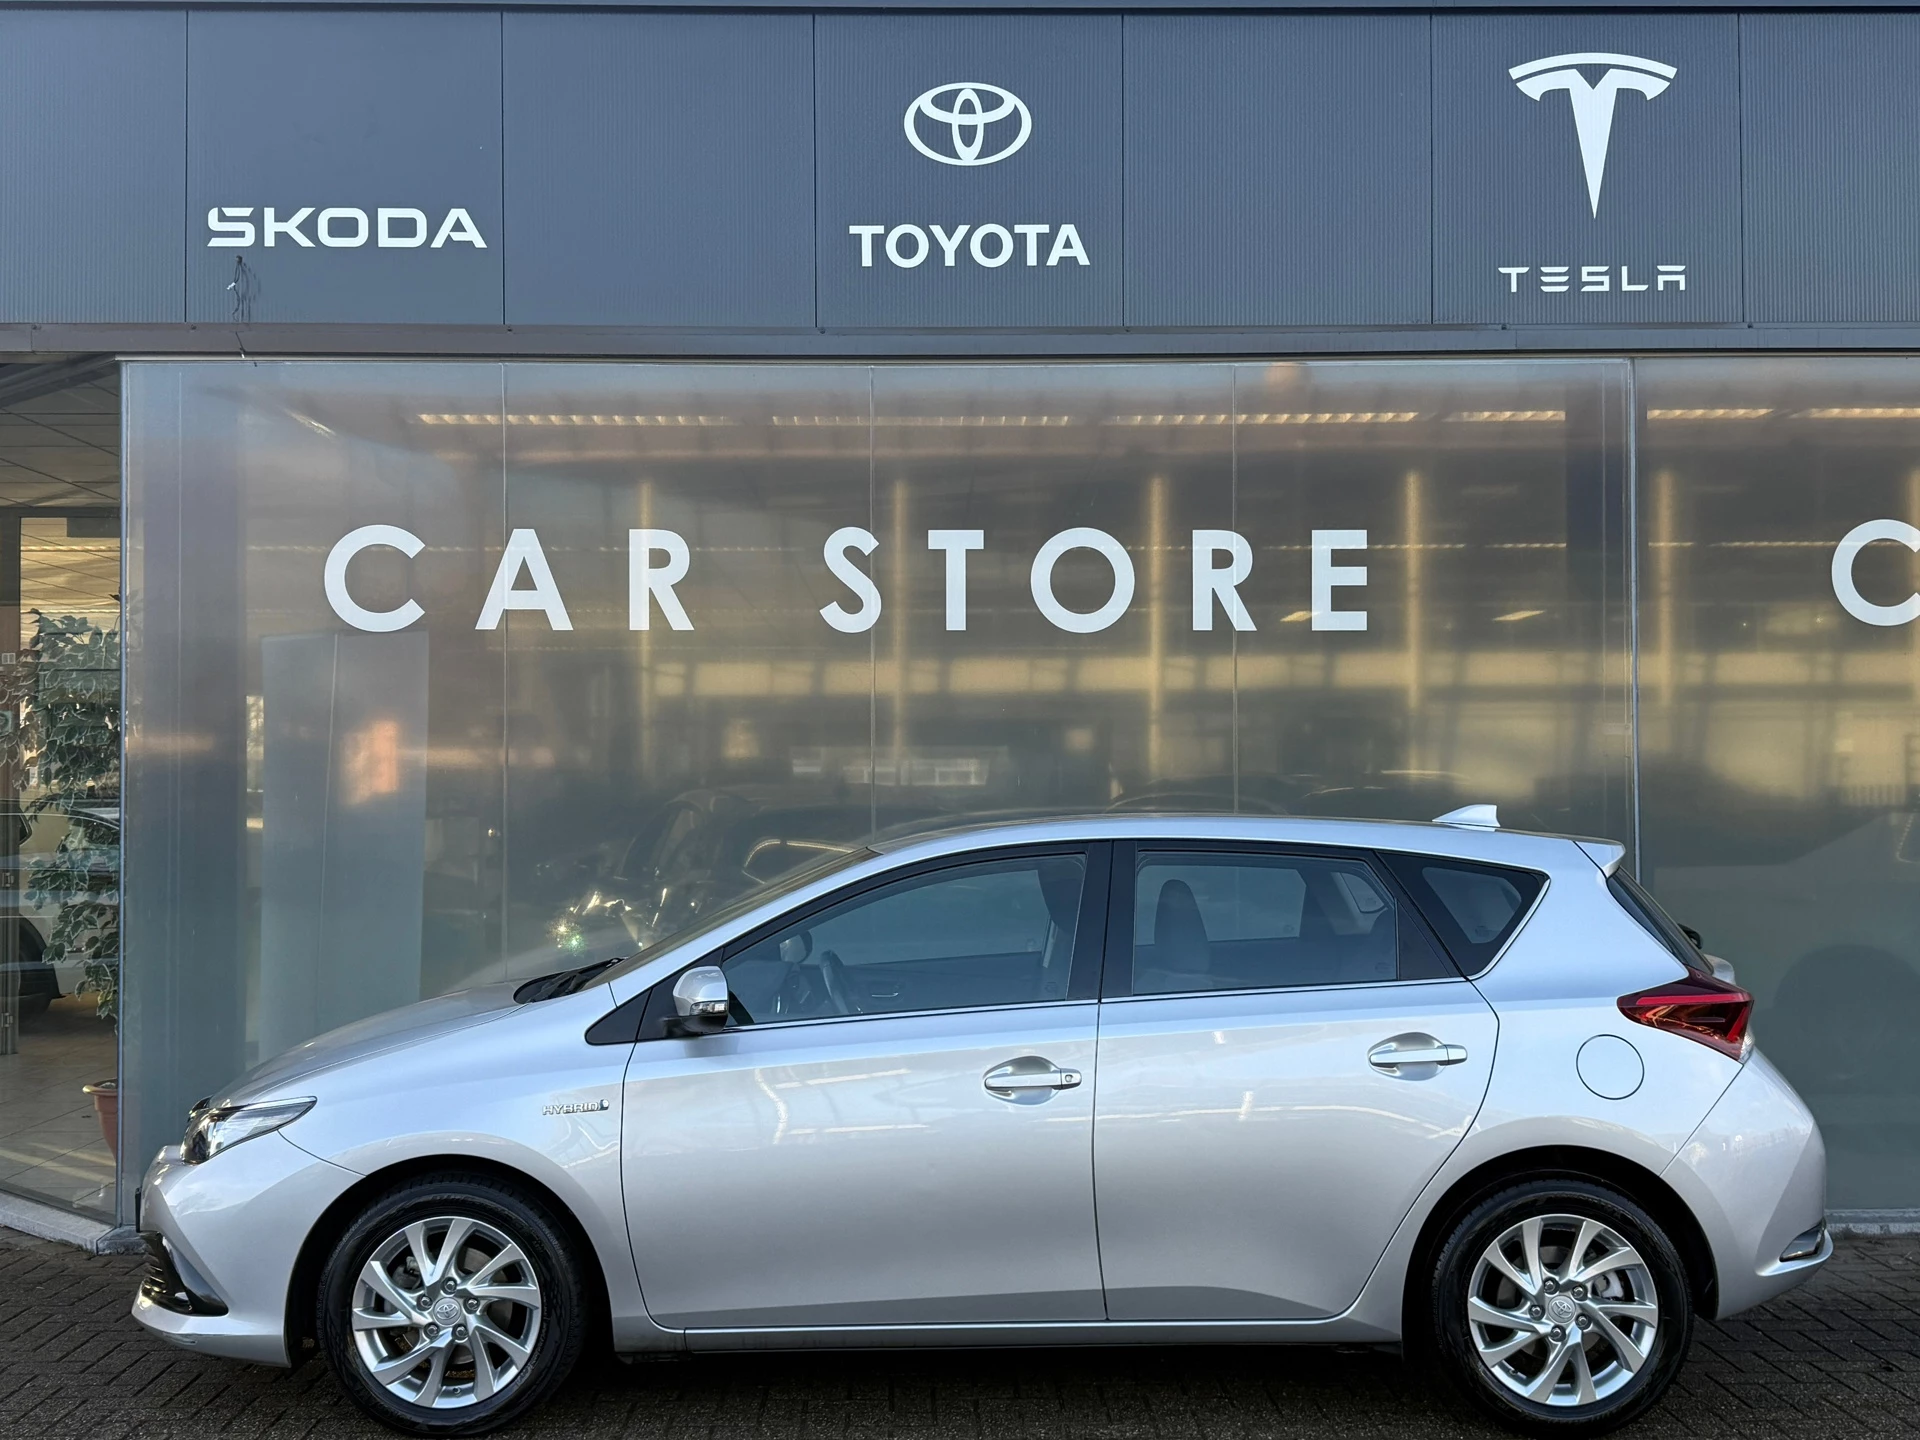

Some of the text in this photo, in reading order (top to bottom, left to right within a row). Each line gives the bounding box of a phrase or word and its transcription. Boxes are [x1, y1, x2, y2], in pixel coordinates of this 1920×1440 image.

[207, 207, 488, 249] SKODA
[849, 223, 1091, 269] TOYOTA
[1497, 264, 1687, 293] TESLA
[323, 524, 1369, 635] CAR STORE
[542, 1101, 599, 1116] HYBRID
